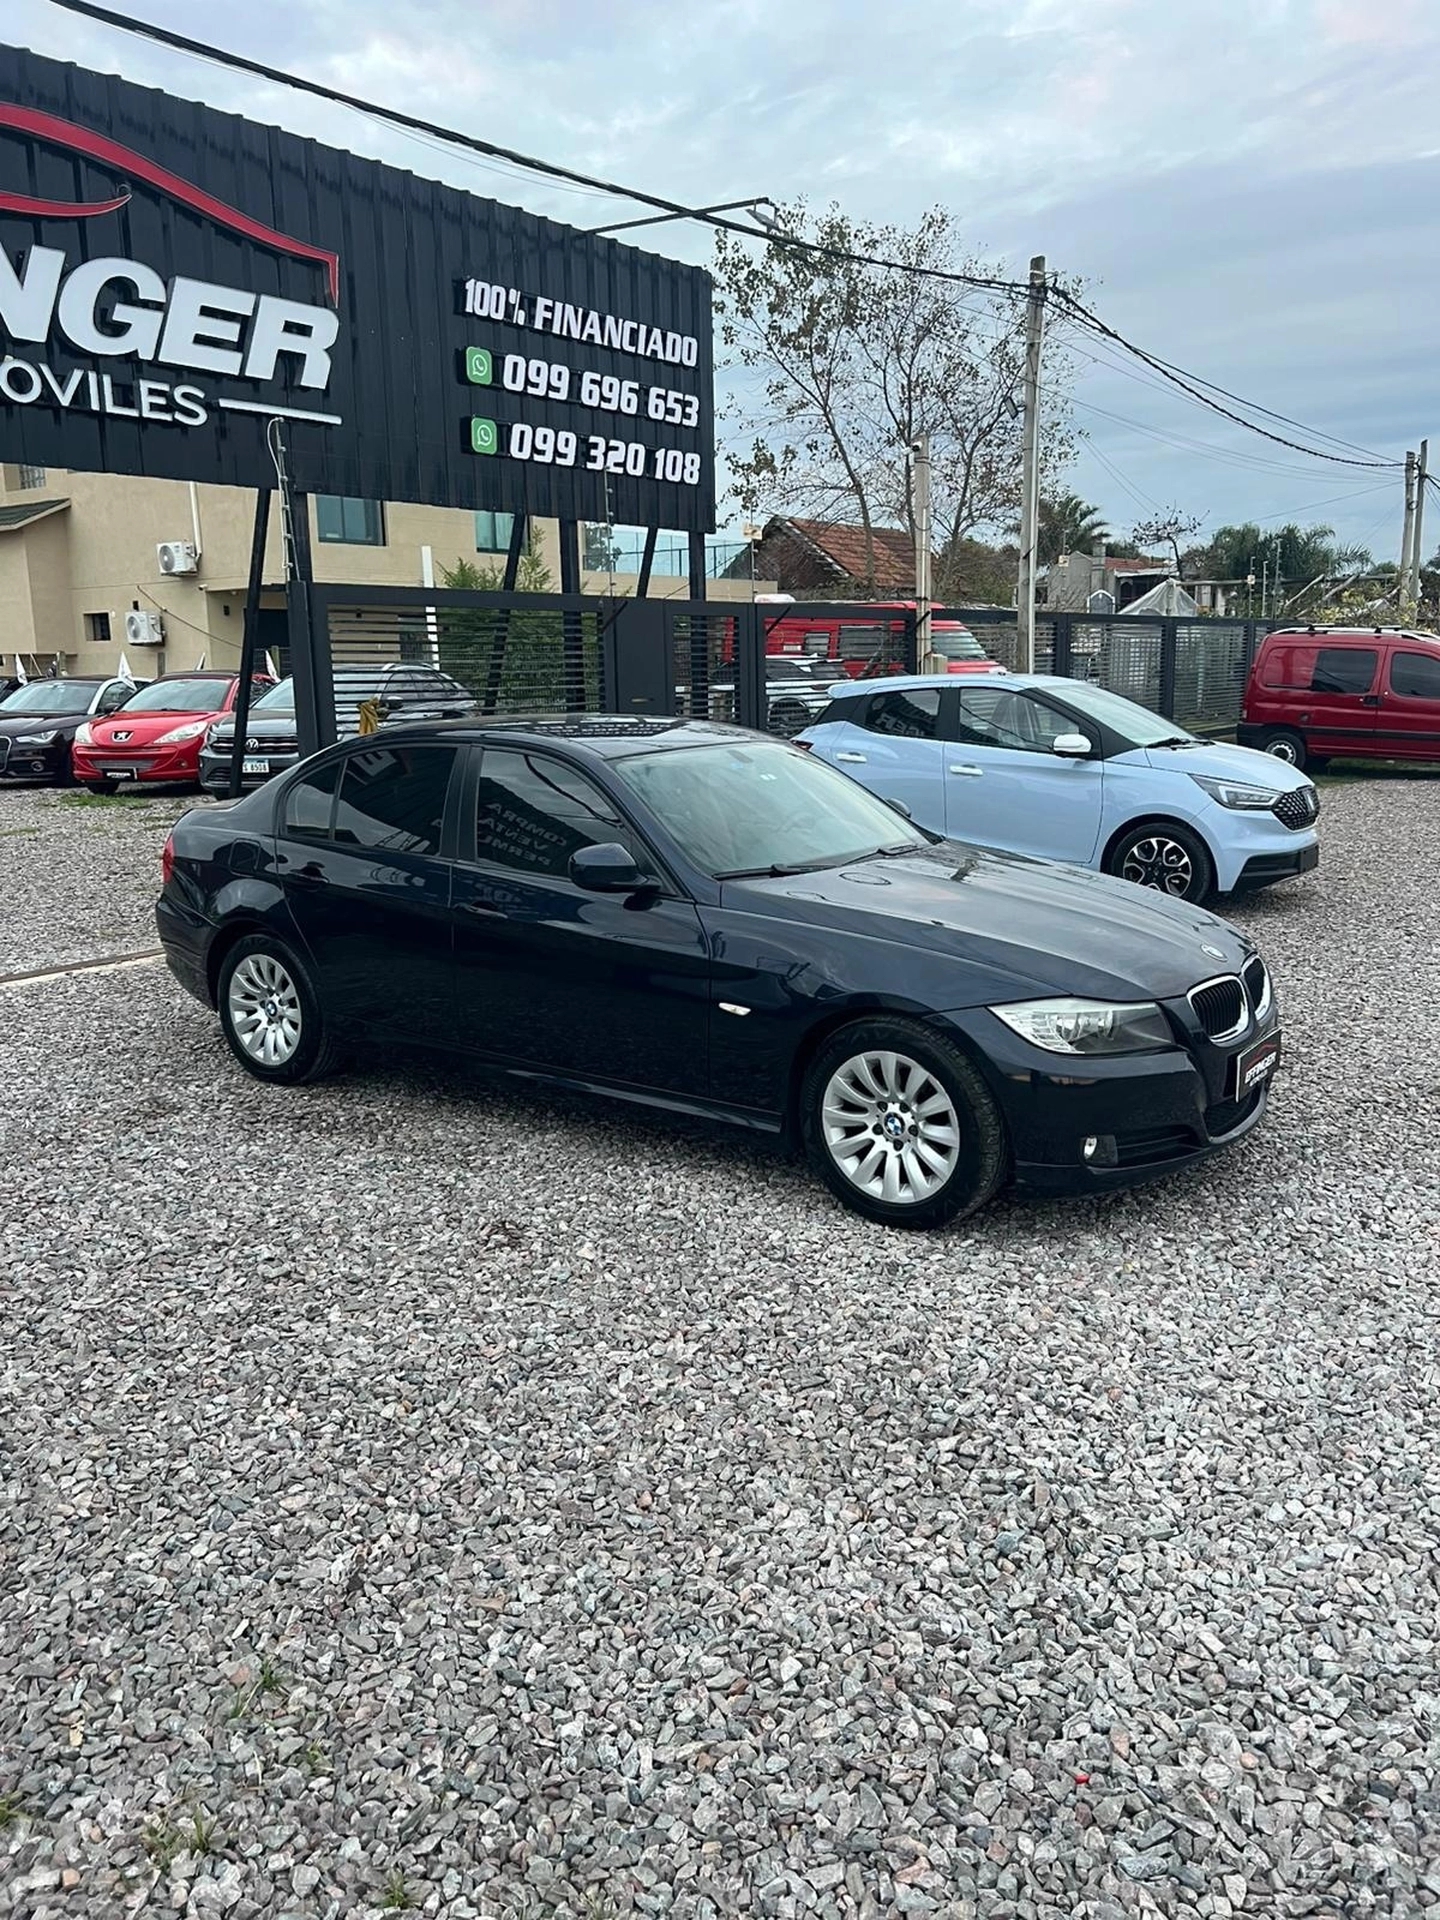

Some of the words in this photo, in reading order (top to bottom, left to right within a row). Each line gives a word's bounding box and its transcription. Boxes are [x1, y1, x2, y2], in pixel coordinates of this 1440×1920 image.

[465, 278, 526, 326] 100%
[533, 296, 698, 367] FINANCIADO
[502, 354, 570, 401] 099
[580, 371, 640, 415] 696
[648, 386, 700, 427] 653
[510, 423, 577, 466] 099
[586, 435, 646, 476] 320
[655, 448, 701, 485] 108
